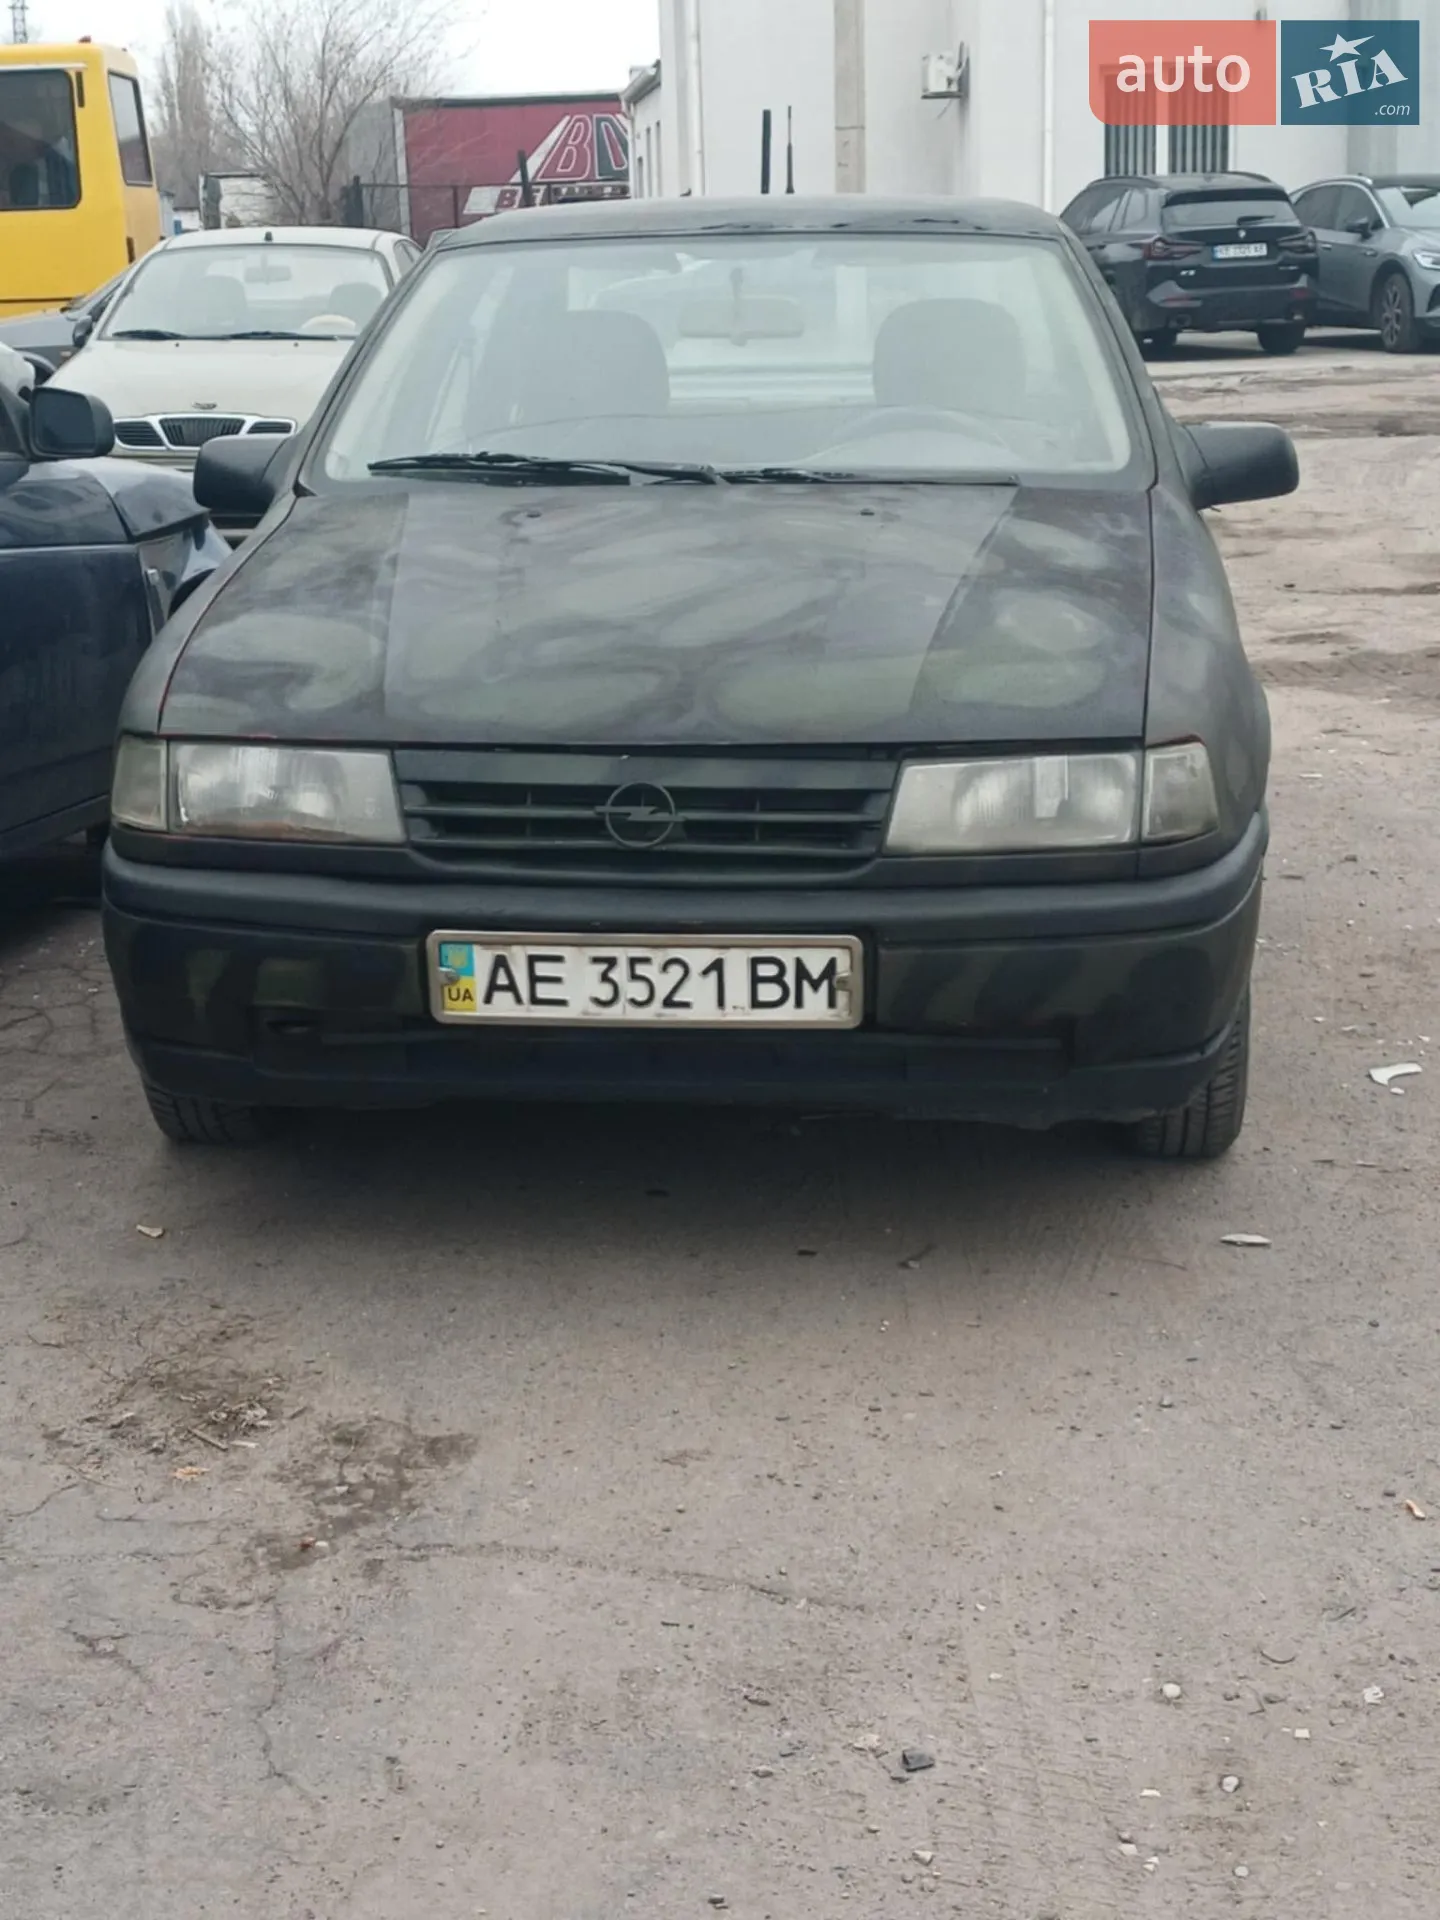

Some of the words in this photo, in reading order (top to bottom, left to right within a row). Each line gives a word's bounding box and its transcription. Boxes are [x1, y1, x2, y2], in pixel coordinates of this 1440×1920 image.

[447, 987, 474, 1002] UA
[483, 954, 569, 1006] AE
[588, 956, 726, 1009] 3521
[750, 956, 837, 1010] BM
